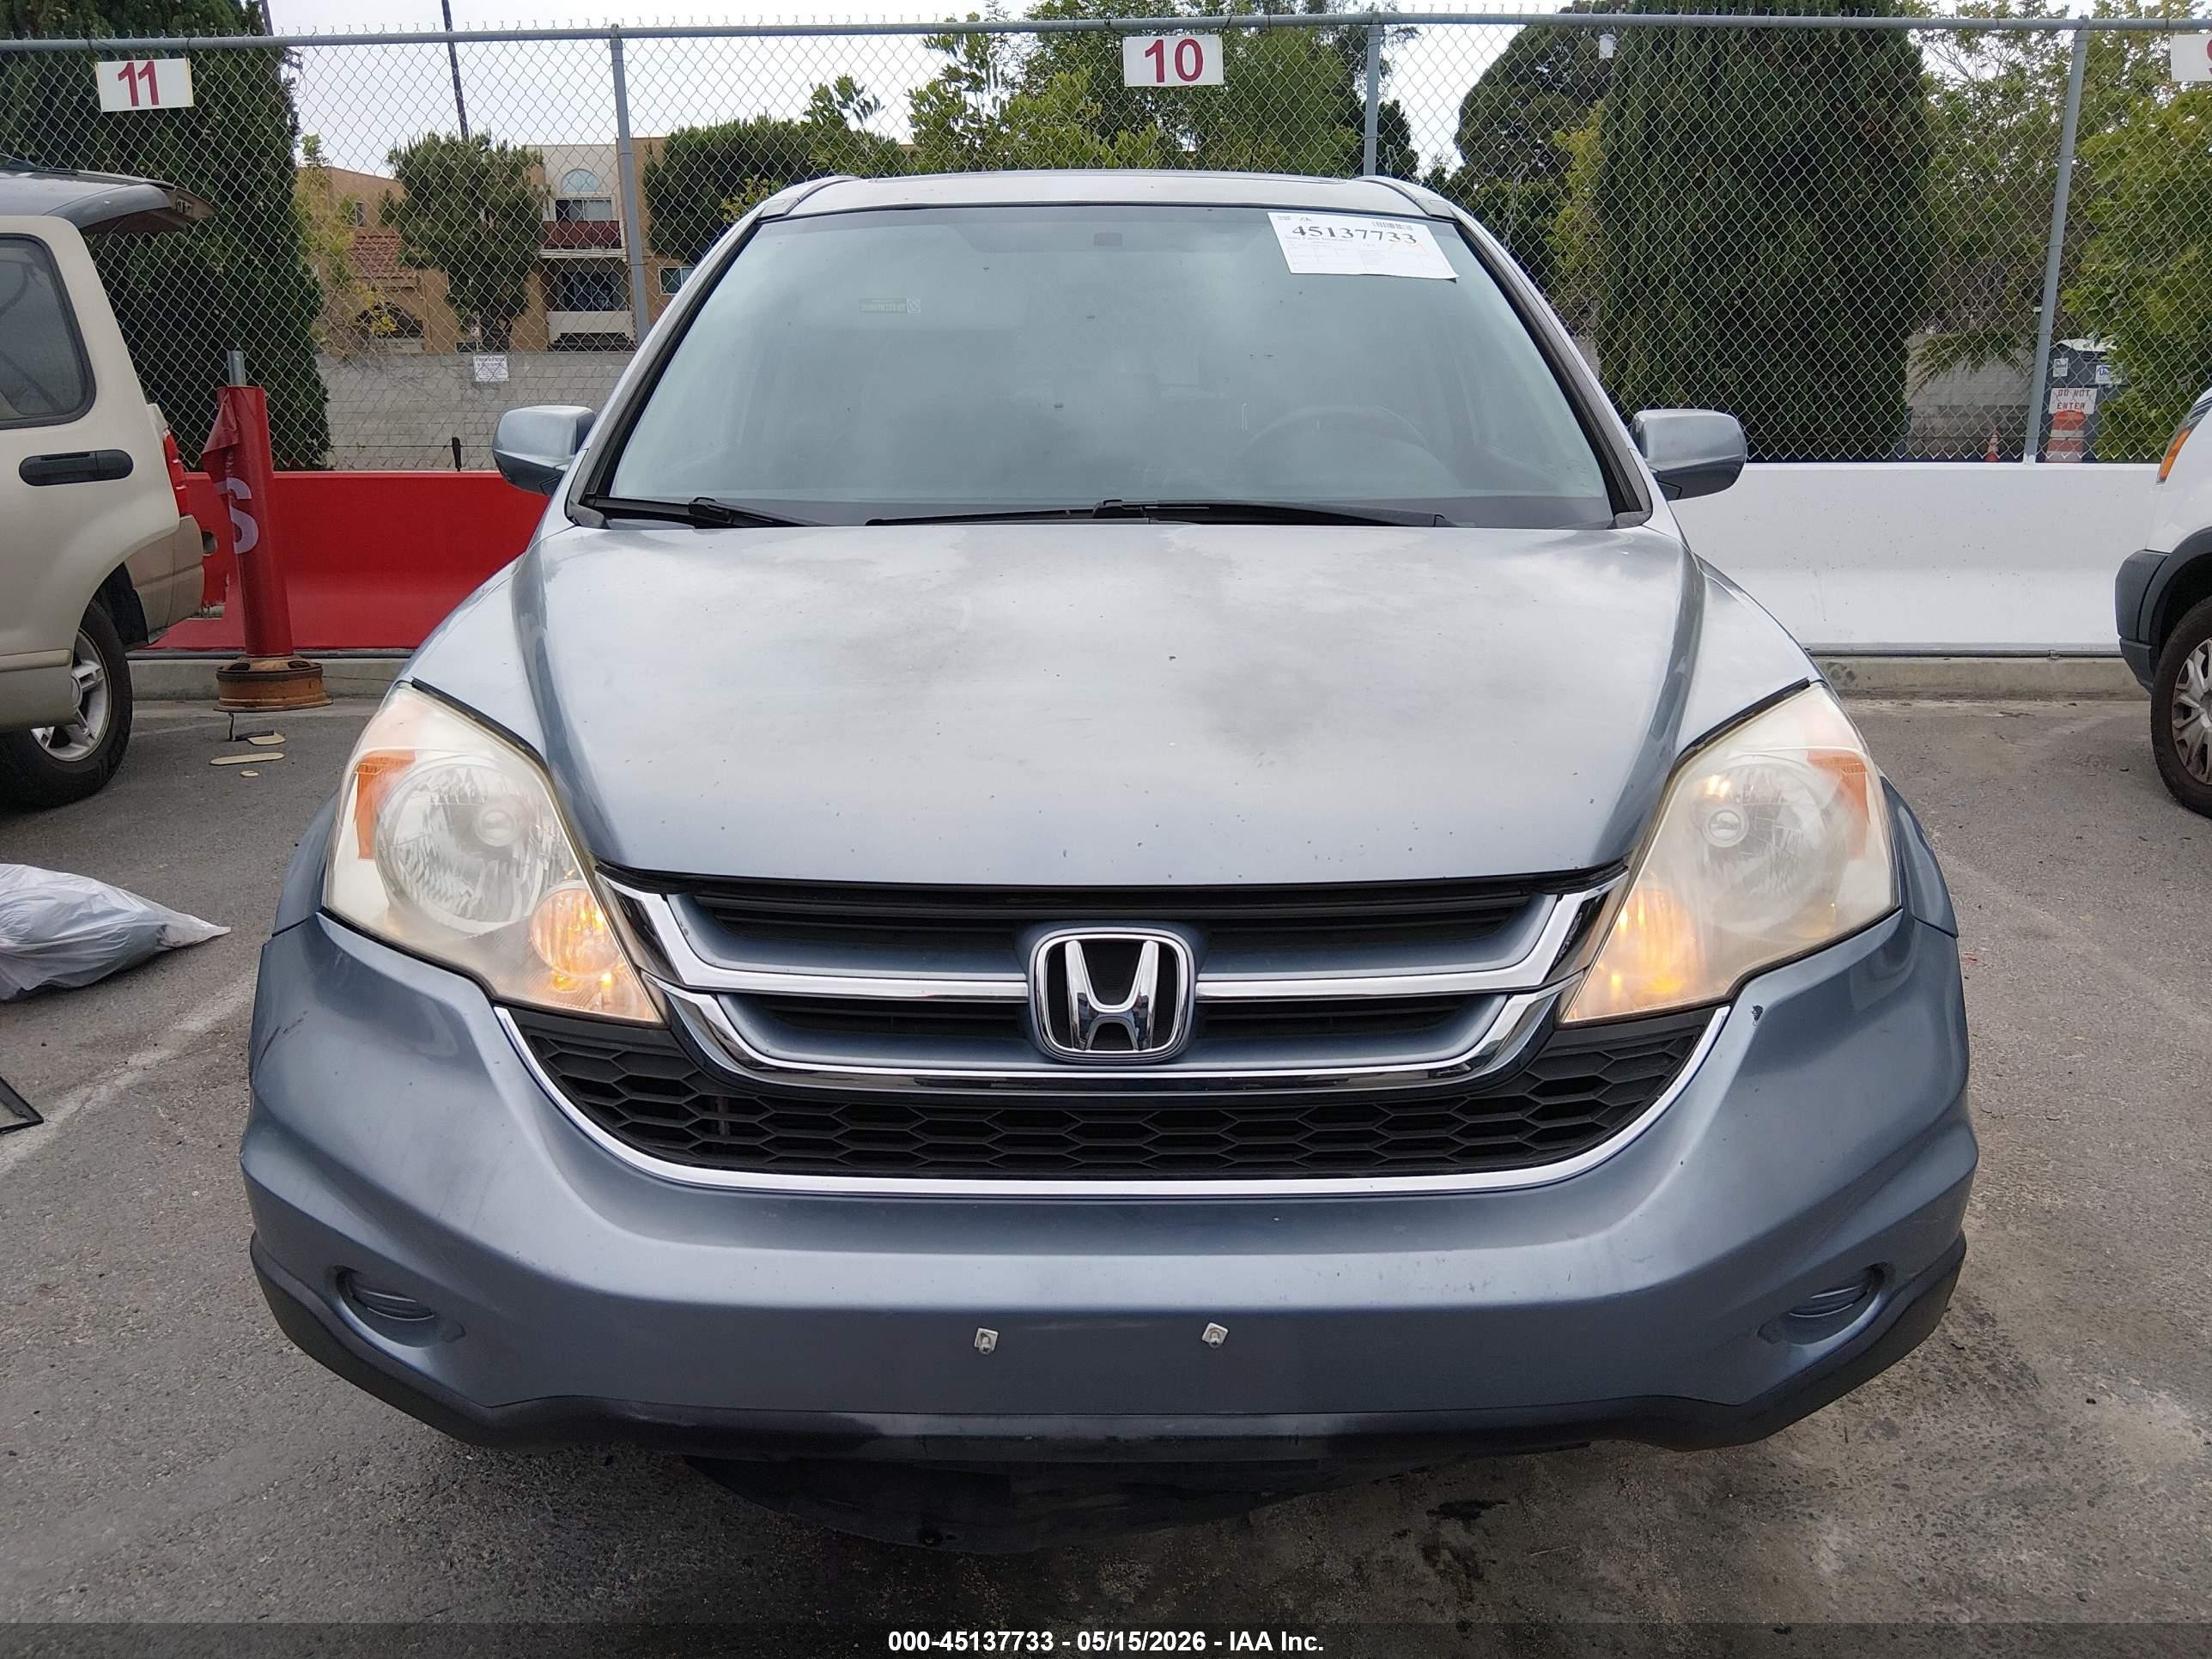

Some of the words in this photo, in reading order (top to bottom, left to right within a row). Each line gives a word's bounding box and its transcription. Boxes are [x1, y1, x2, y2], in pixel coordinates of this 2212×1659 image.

[1144, 38, 1204, 83] 10
[117, 61, 160, 107] 11
[1292, 226, 1417, 245] 45137733
